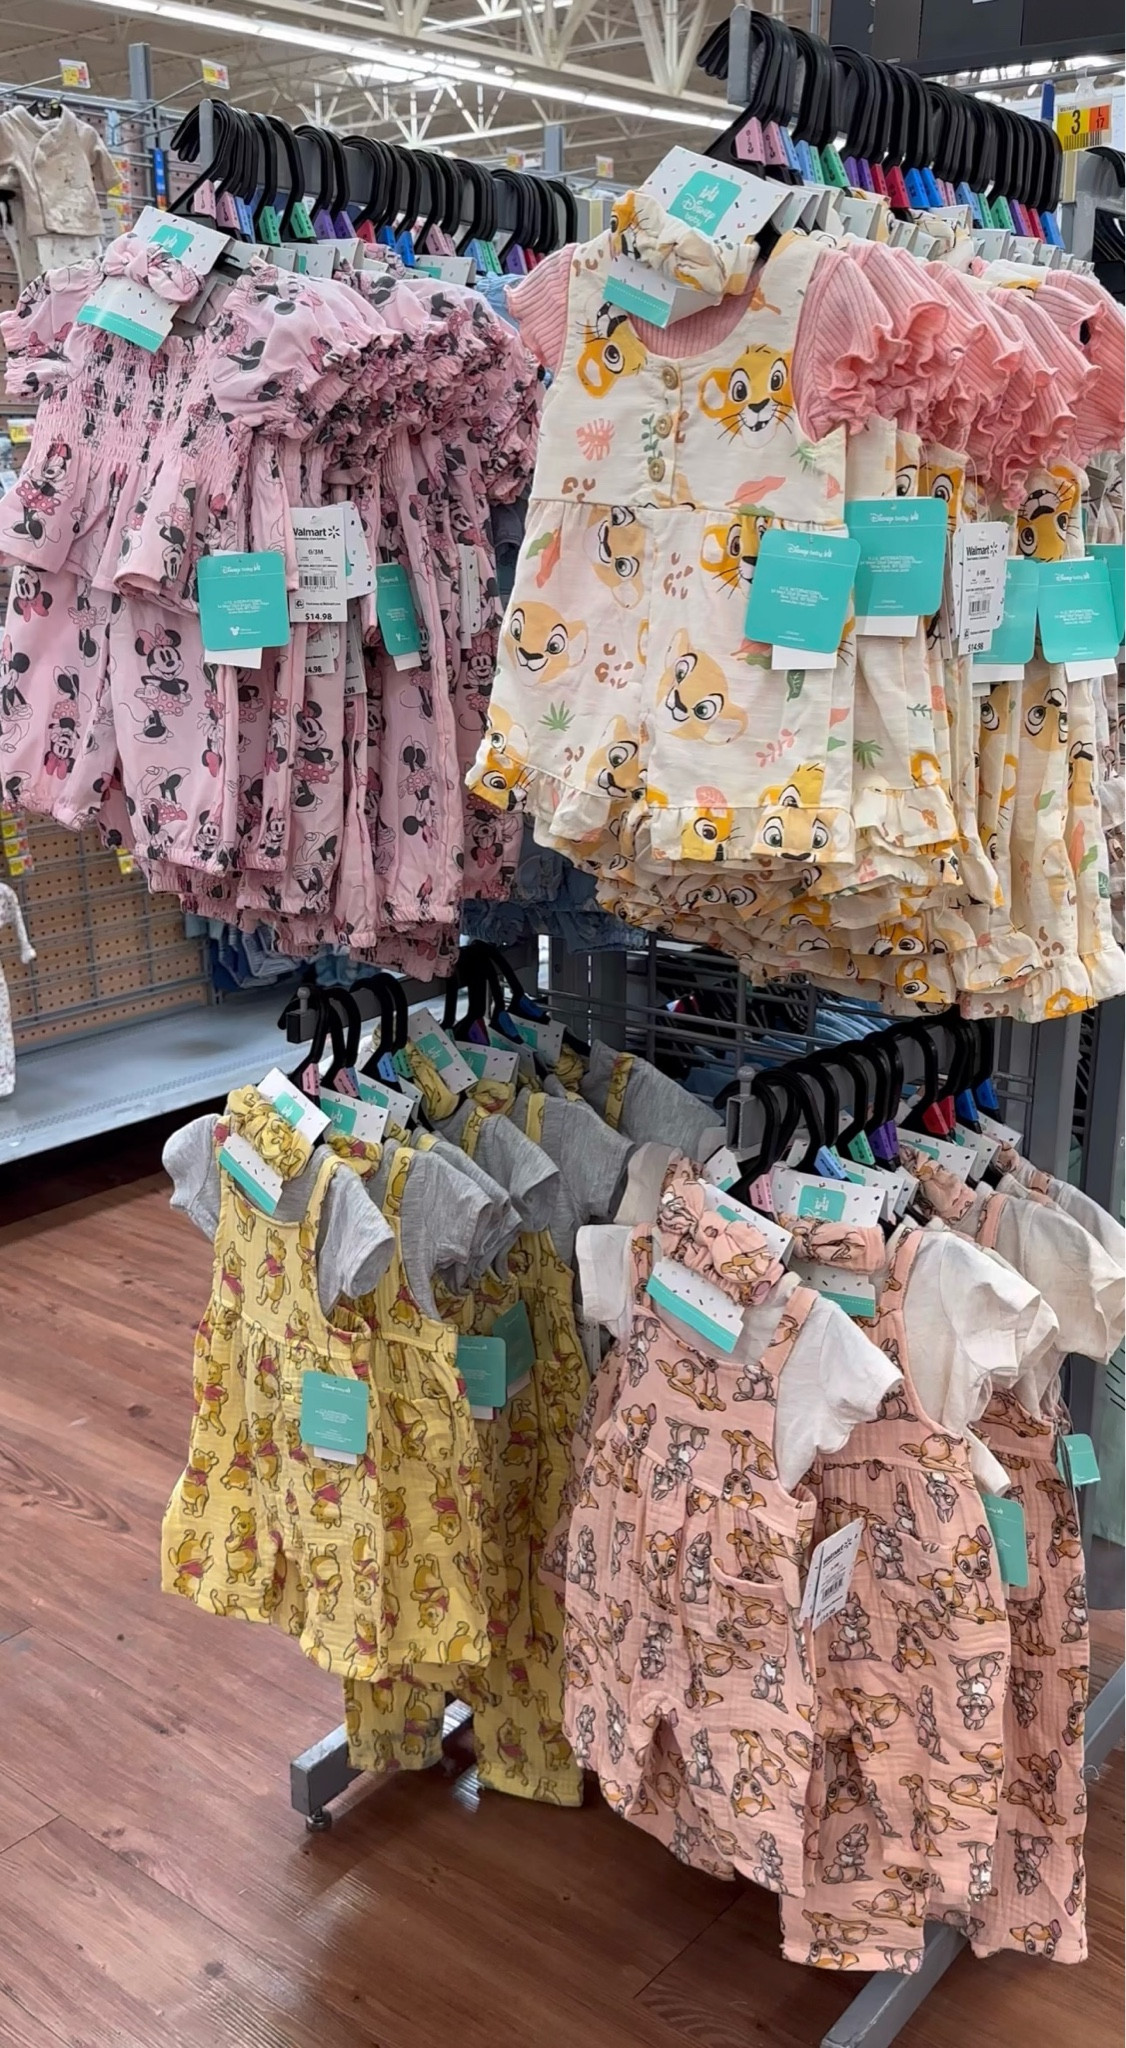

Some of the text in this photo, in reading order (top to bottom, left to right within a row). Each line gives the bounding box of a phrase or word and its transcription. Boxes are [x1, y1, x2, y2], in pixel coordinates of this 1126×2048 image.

[1071, 109, 1081, 135] 3
[1096, 118, 1105, 128] 17
[682, 193, 716, 223] Disney
[966, 545, 990, 556] Walmart
